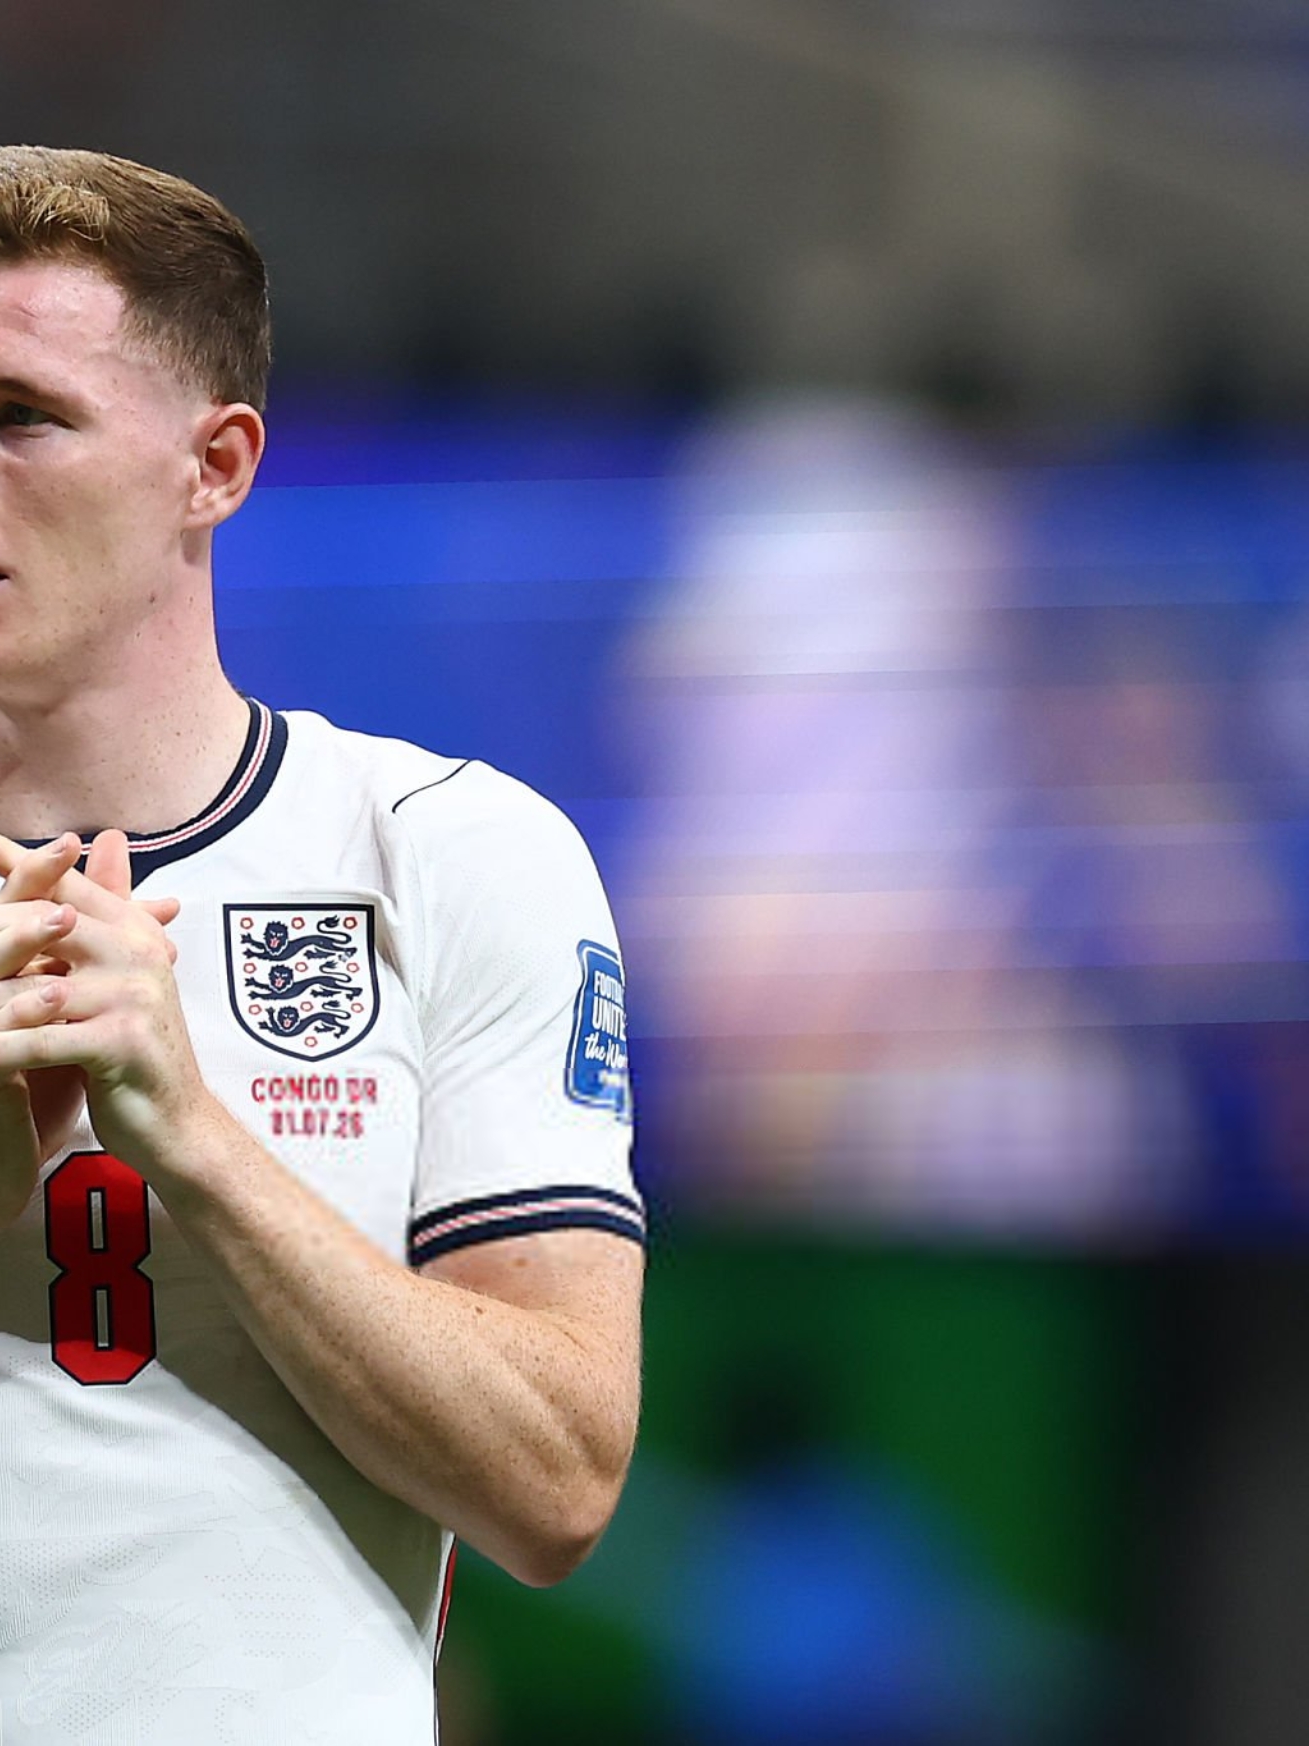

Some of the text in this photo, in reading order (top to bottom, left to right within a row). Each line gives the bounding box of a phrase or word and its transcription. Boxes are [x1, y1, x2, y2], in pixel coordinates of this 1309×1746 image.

[592, 996, 627, 1041] UNITE
[584, 1031, 606, 1061] the
[251, 1075, 377, 1103] CONGO DR
[44, 1150, 157, 1386] 8
